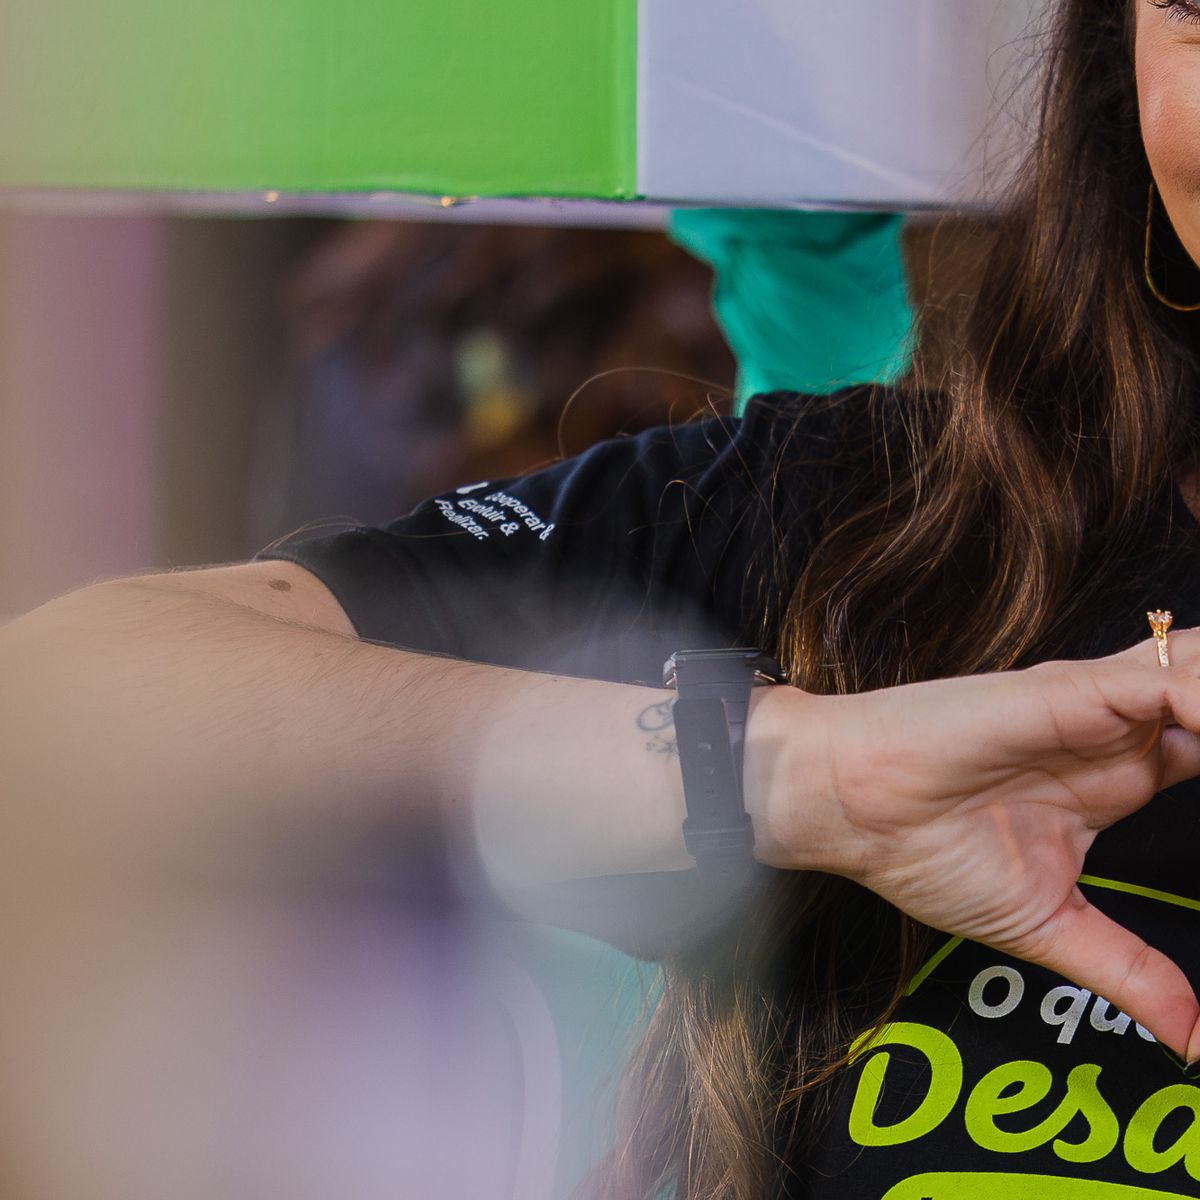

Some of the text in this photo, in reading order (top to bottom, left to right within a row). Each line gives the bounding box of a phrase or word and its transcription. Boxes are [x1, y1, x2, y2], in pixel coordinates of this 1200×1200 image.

[500, 522, 519, 536] &
[539, 523, 555, 541] &
[968, 965, 1025, 1019] O
[1040, 985, 1158, 1045] qu
